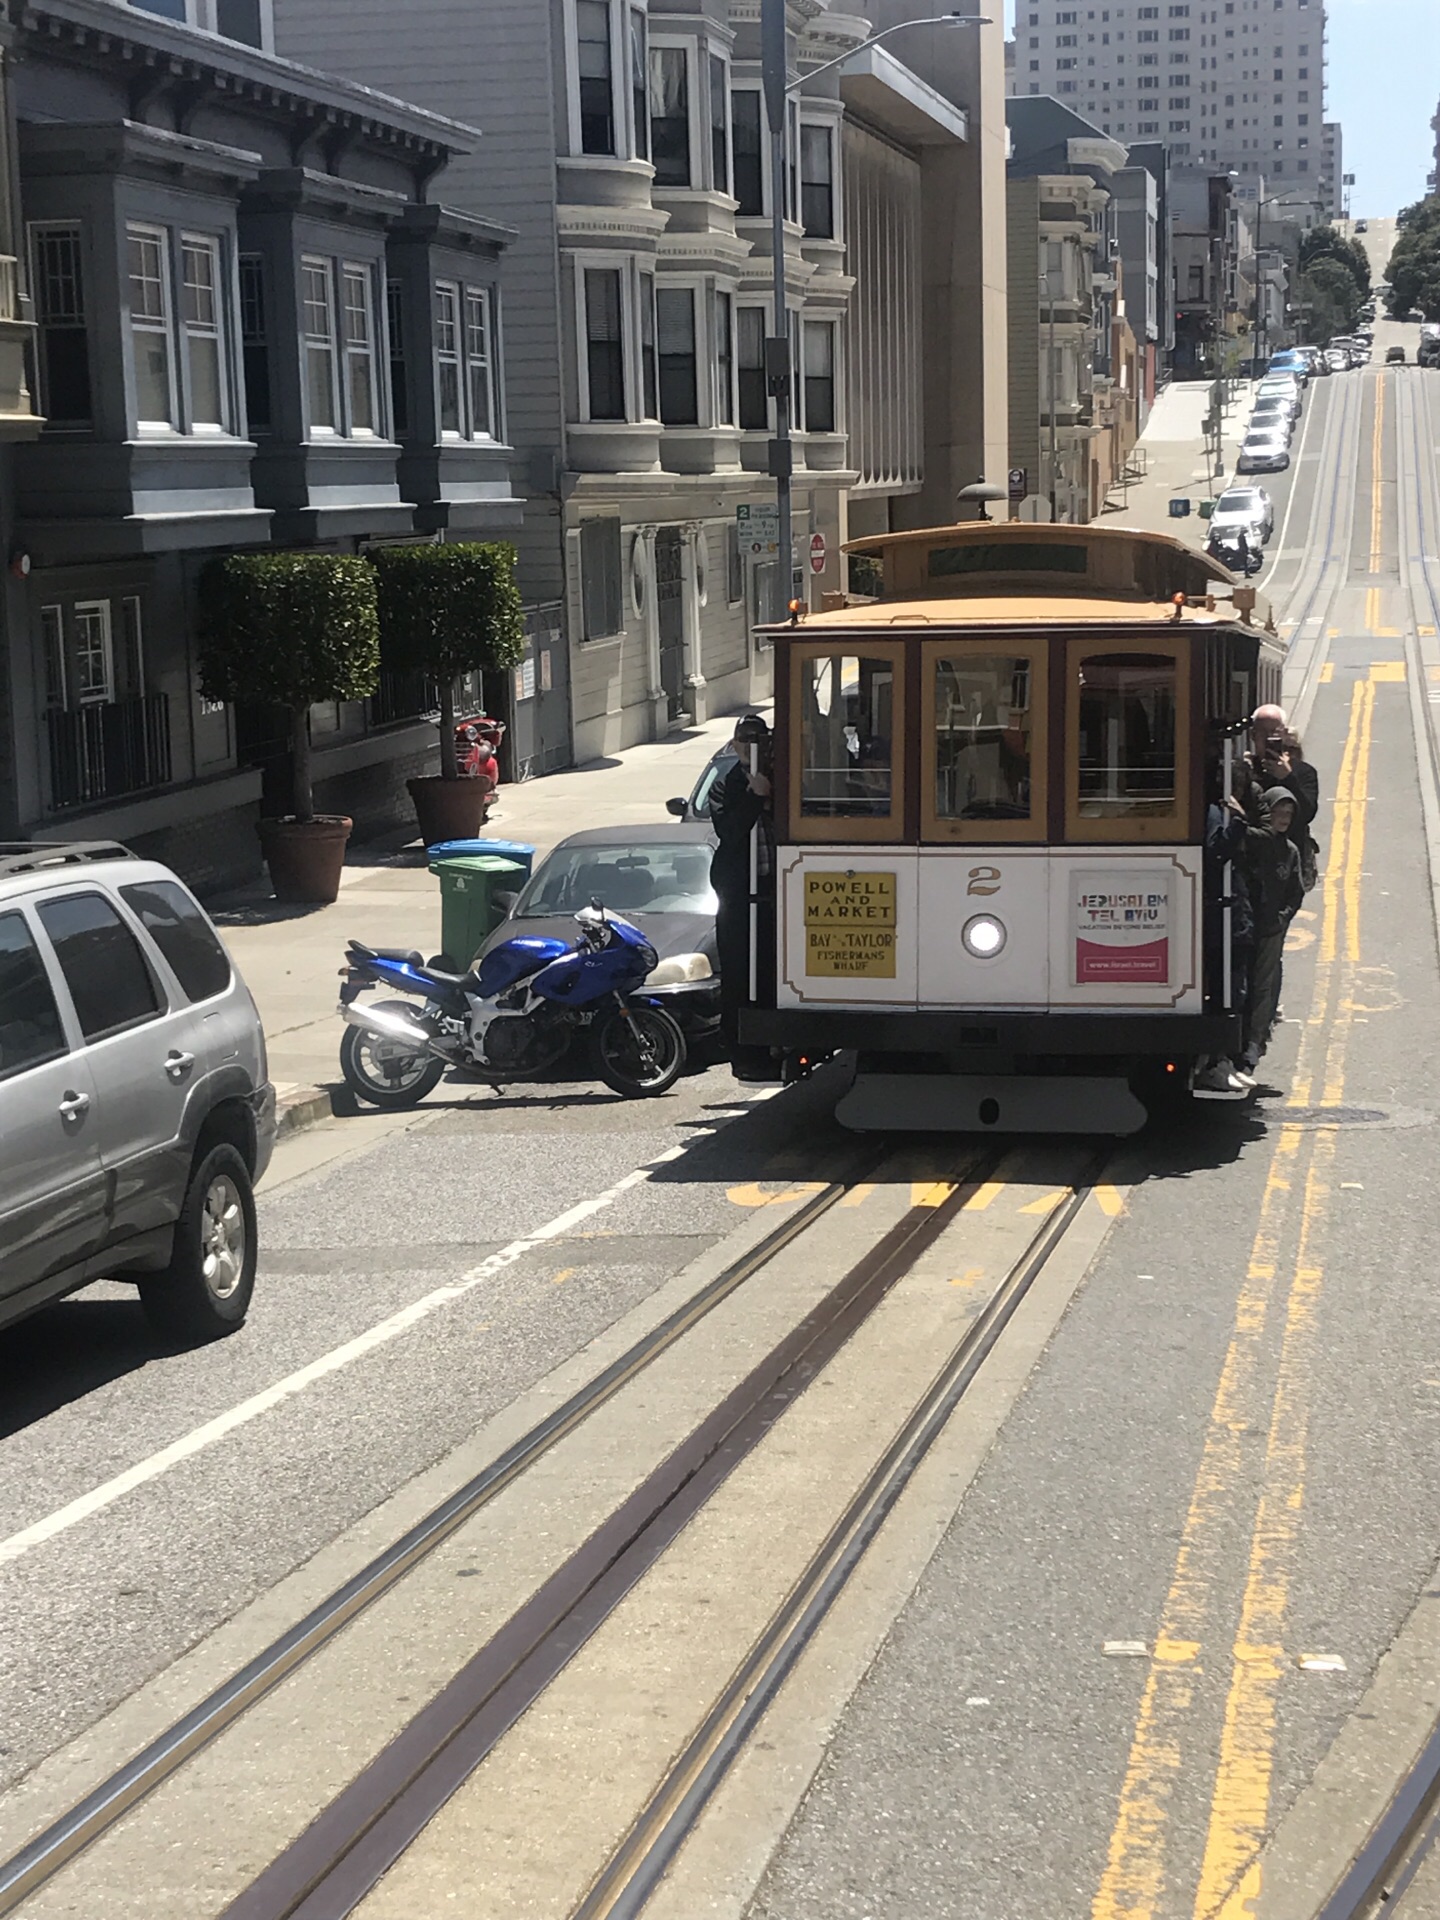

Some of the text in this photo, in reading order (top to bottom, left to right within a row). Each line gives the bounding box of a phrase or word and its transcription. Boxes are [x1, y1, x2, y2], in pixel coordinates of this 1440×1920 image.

[739, 506, 748, 518] 2
[967, 866, 1001, 896] 2
[809, 881, 890, 895] POWELL
[830, 895, 871, 905] AND
[808, 905, 891, 918] MARKET
[1087, 909, 1120, 922] TEL
[810, 933, 831, 947] BAY
[846, 933, 893, 948] TAYLOR
[817, 950, 885, 961] FISHERMANS
[833, 961, 869, 971] WHARF
